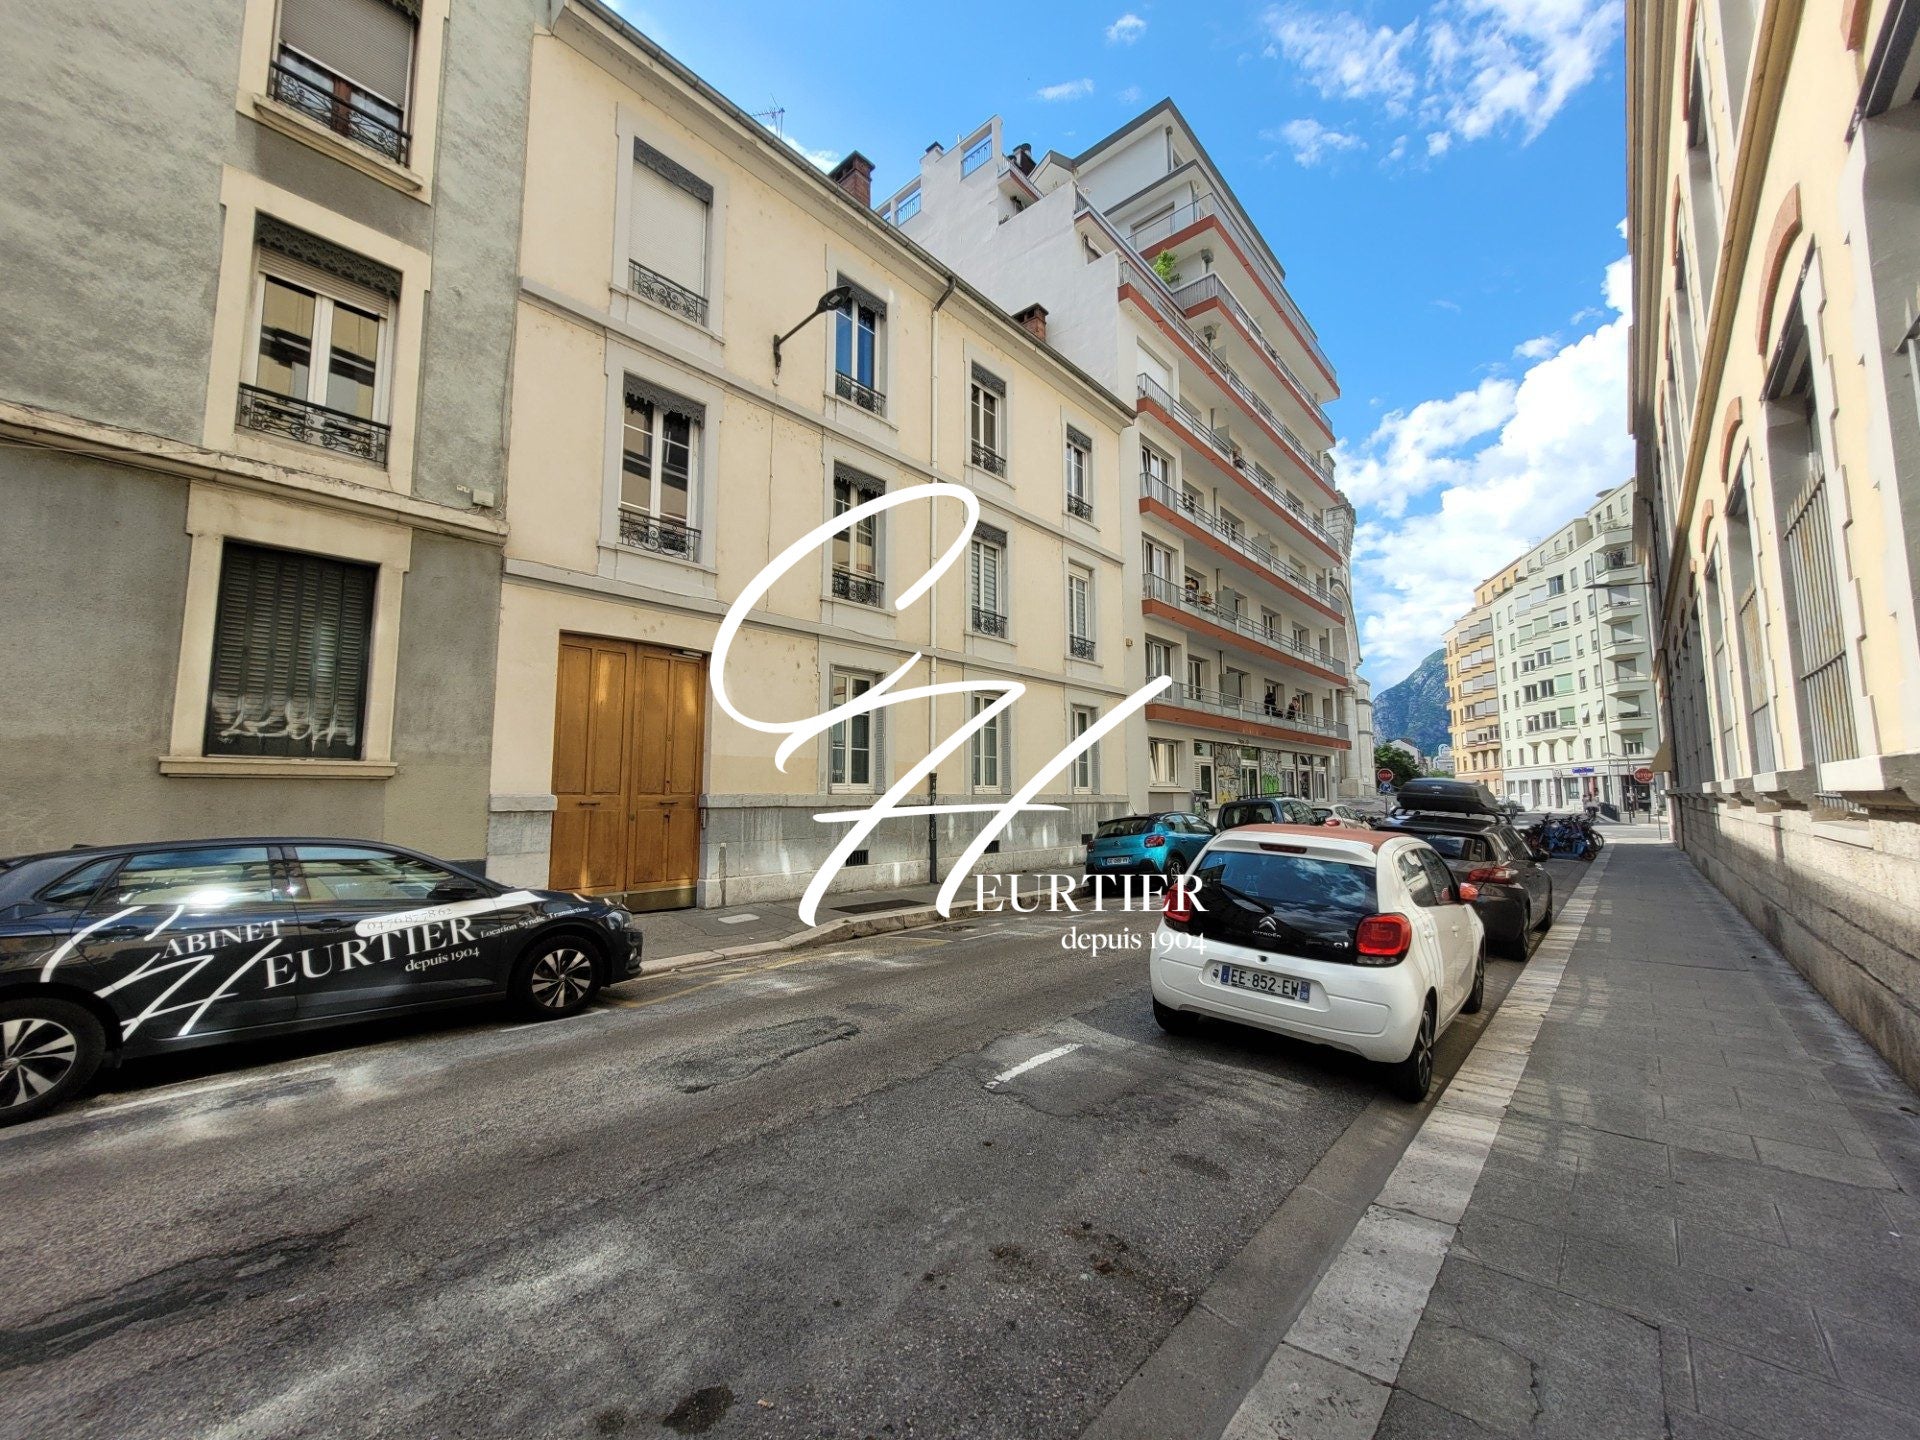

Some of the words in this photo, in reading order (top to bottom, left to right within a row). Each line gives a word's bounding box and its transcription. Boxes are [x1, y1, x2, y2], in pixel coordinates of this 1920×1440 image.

[480, 923, 517, 939] Location
[519, 915, 546, 929] Syndic
[549, 906, 590, 919] Transaction
[404, 952, 449, 972] depuis
[450, 946, 480, 963] 1904
[1230, 968, 1300, 997] EE-852-EW
